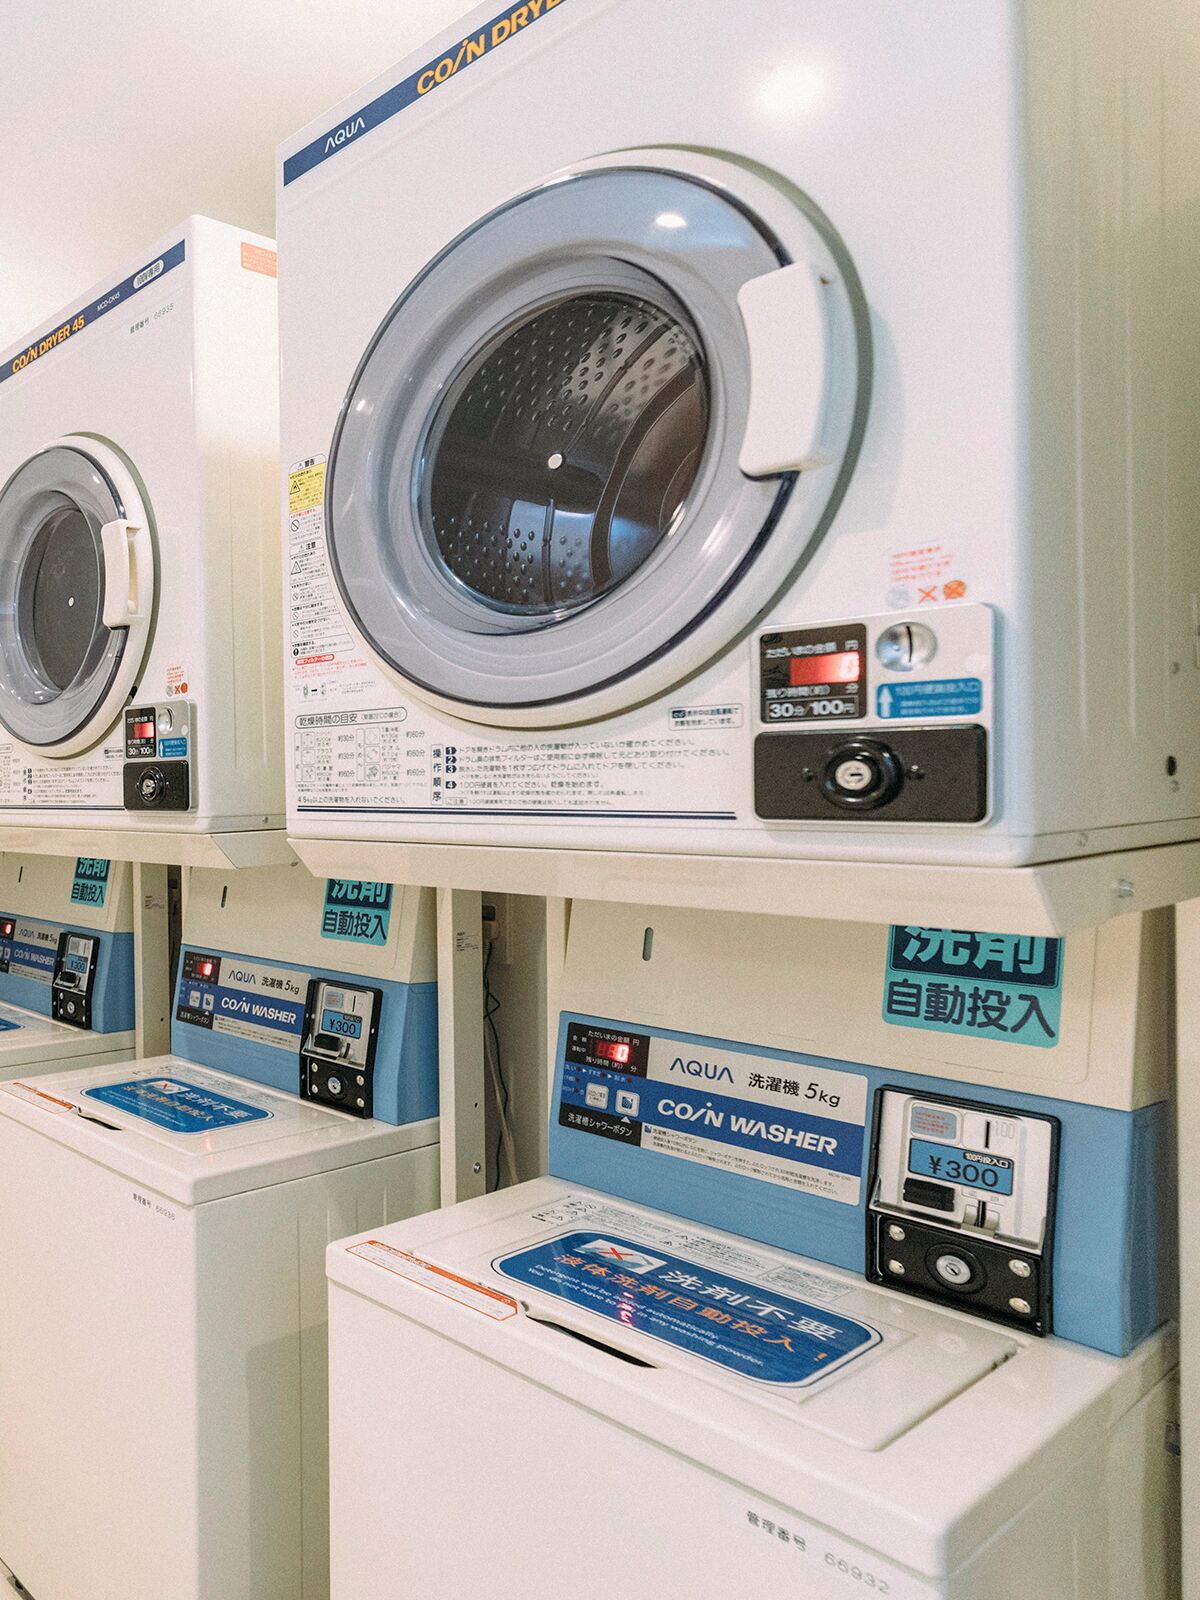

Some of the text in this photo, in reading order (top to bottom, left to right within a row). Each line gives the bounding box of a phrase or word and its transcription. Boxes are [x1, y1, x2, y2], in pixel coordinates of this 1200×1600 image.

[324, 117, 366, 153] AQUA
[39, 324, 71, 357] DRYER
[71, 314, 85, 332] 45
[299, 713, 359, 727] 乾燥時間の目安
[128, 746, 154, 756] 30100
[70, 882, 105, 904] 自動投入
[322, 909, 387, 941] 自動投入
[228, 970, 300, 995] AQUA 洗濯機 5kg
[252, 1003, 297, 1025] WASHER
[886, 978, 1056, 1039] 自動投入
[329, 1018, 356, 1035] ¥300
[588, 1030, 640, 1046] ただいまの金額 円
[630, 1065, 638, 1073] 分
[670, 1057, 841, 1108] AQUA 洗濯機 5kg
[567, 1112, 633, 1137] 洗濯槽シャワーボタン
[657, 1098, 838, 1156] COIN WASHER
[929, 1155, 999, 1187] ¥300
[528, 1267, 544, 1276] You
[580, 1288, 604, 1300] have
[670, 1324, 716, 1346] washing
[716, 1343, 764, 1367] powder.
[534, 1264, 580, 1283] Detergent
[581, 1282, 599, 1291] will
[646, 1308, 719, 1340] automatically.
[658, 1270, 843, 1341] 洗剤不要
[746, 1510, 890, 1595] 管理番号 66932
